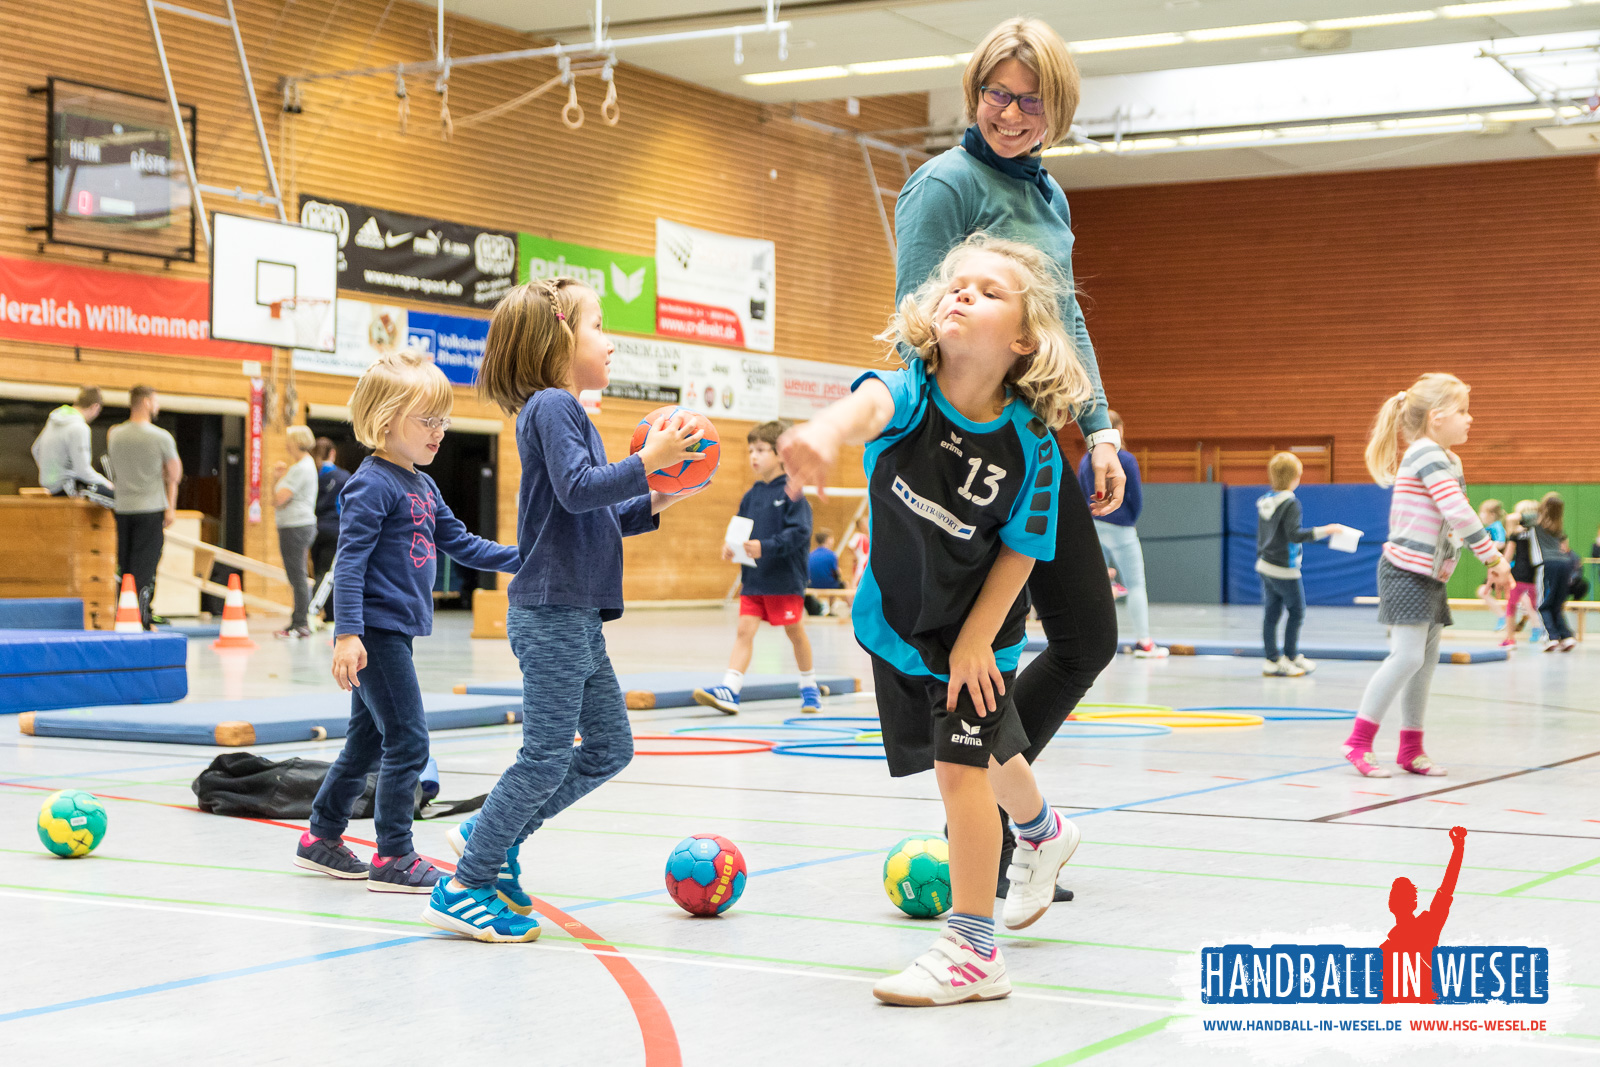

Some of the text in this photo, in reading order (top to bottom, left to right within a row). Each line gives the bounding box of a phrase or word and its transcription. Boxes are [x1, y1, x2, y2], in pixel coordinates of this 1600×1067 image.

[940, 440, 963, 458] erima
[957, 457, 1007, 506] 13
[951, 733, 983, 746] erima
